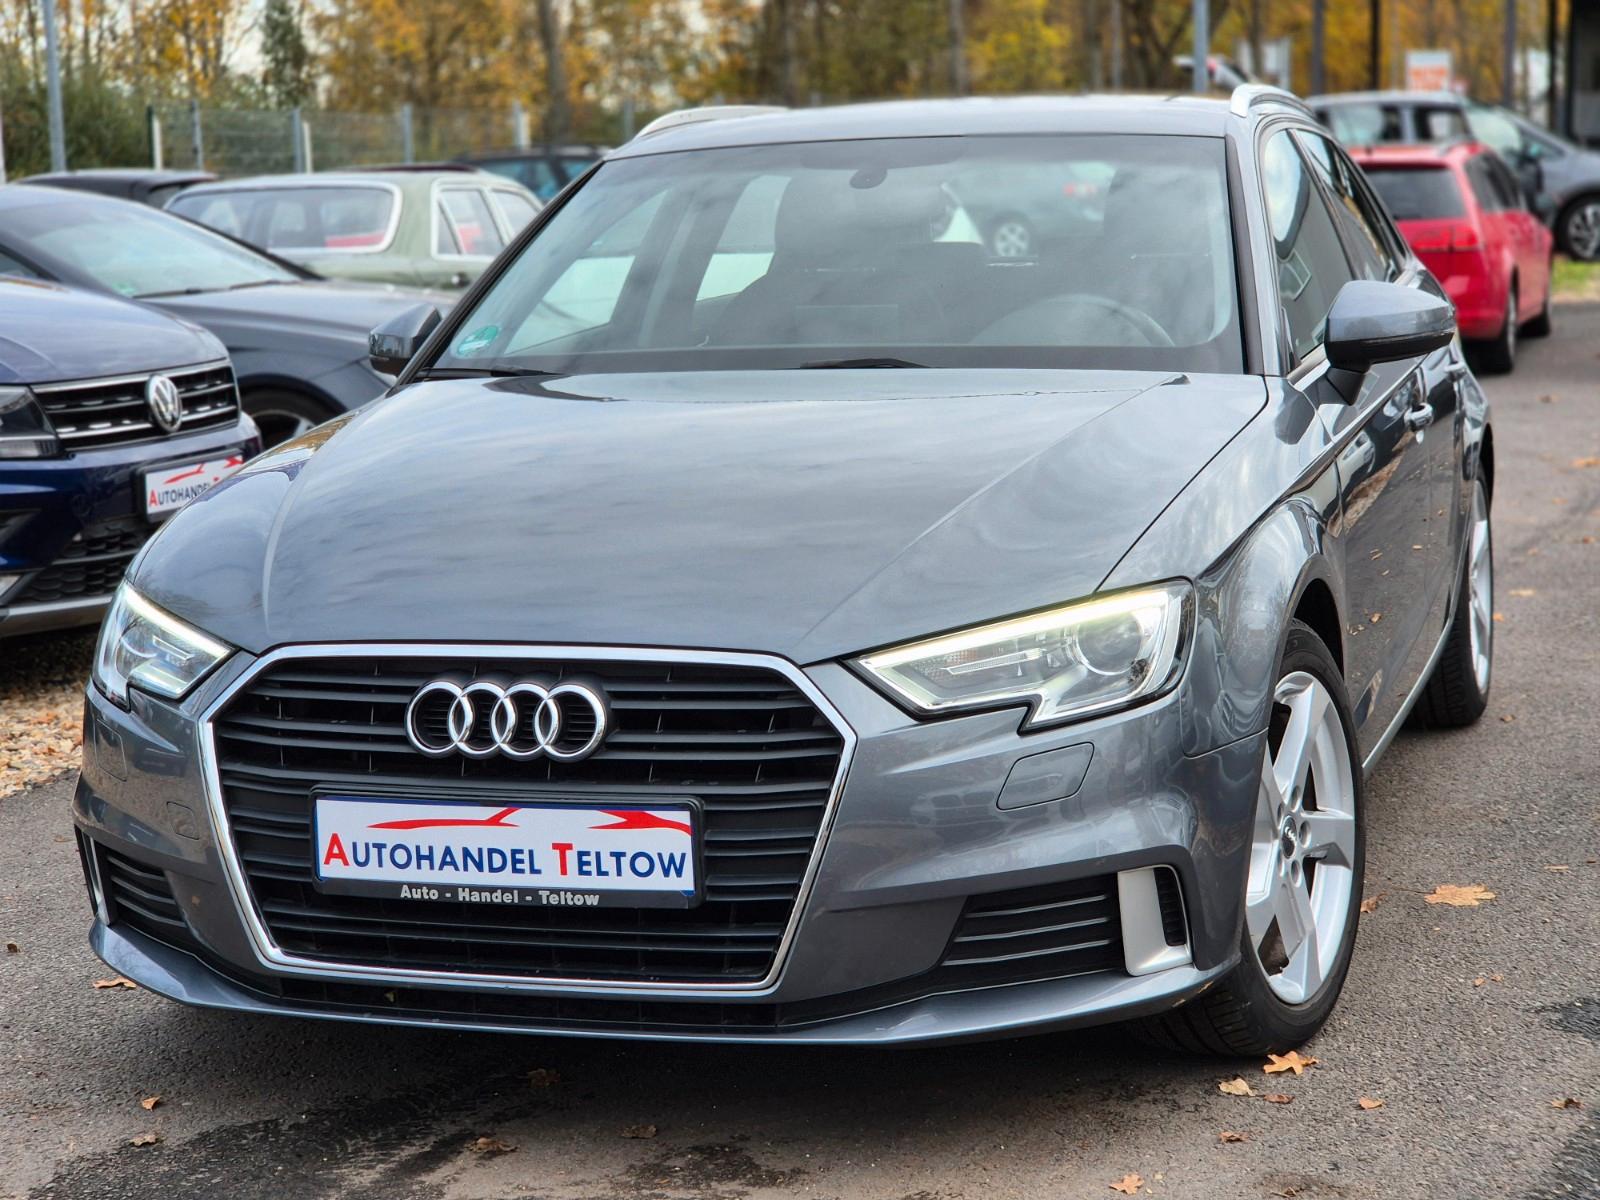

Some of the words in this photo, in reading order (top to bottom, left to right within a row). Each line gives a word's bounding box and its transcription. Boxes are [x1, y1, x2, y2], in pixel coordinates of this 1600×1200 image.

[323, 832, 542, 875] AUTOHANDEL
[551, 842, 687, 878] TELTOW
[400, 884, 439, 900] Auto
[458, 887, 518, 903] Handel
[539, 890, 600, 906] Teltow
